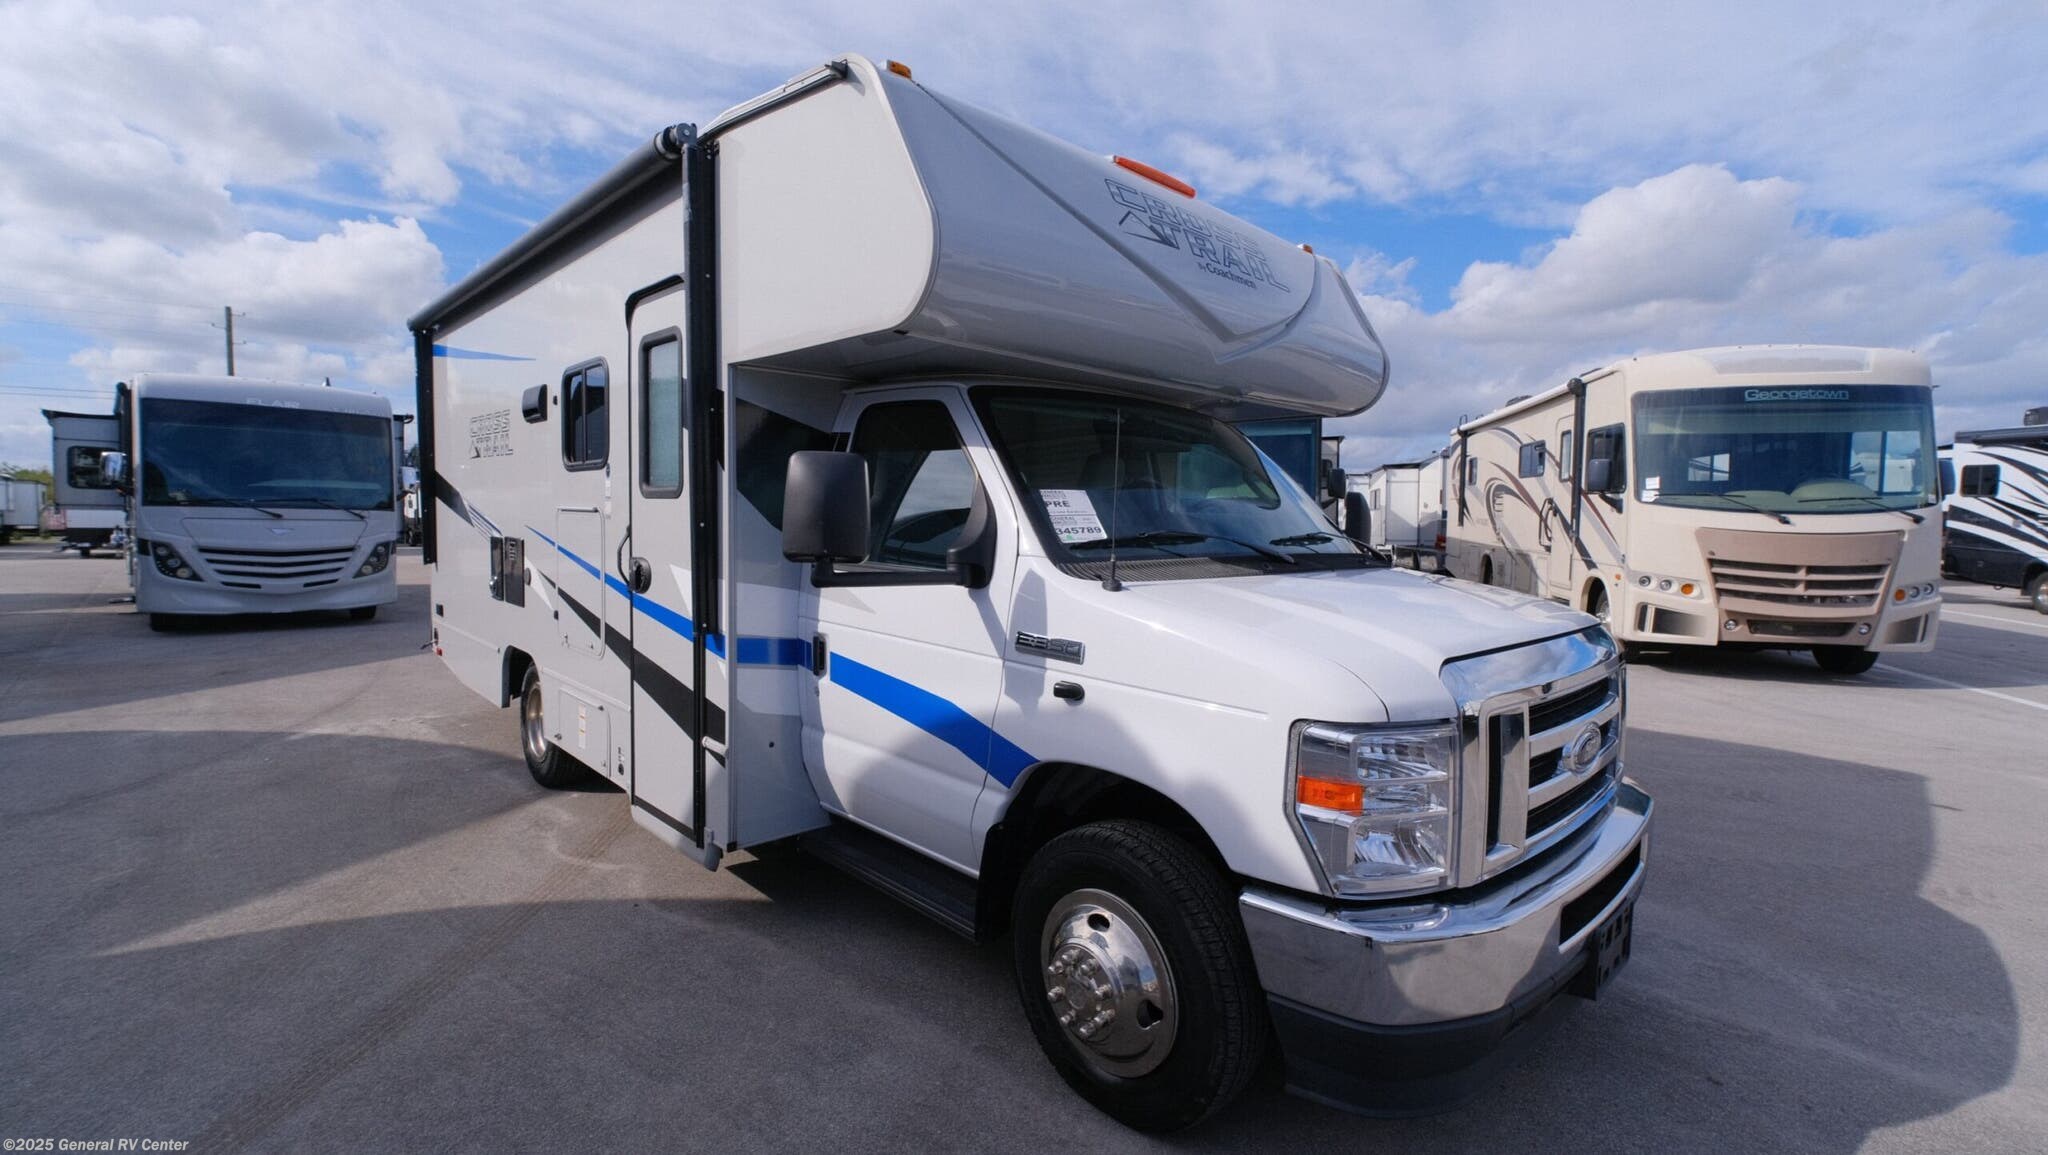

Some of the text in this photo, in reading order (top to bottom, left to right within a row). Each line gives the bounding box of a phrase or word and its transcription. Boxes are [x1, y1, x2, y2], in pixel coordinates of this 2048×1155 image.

[1104, 178, 1267, 262] CROSS
[1148, 216, 1291, 293] TRAIL
[1744, 389, 1849, 401] Georgetown
[470, 409, 511, 438] CROSS
[475, 433, 514, 458] TRAIL
[1046, 500, 1071, 508] PRE
